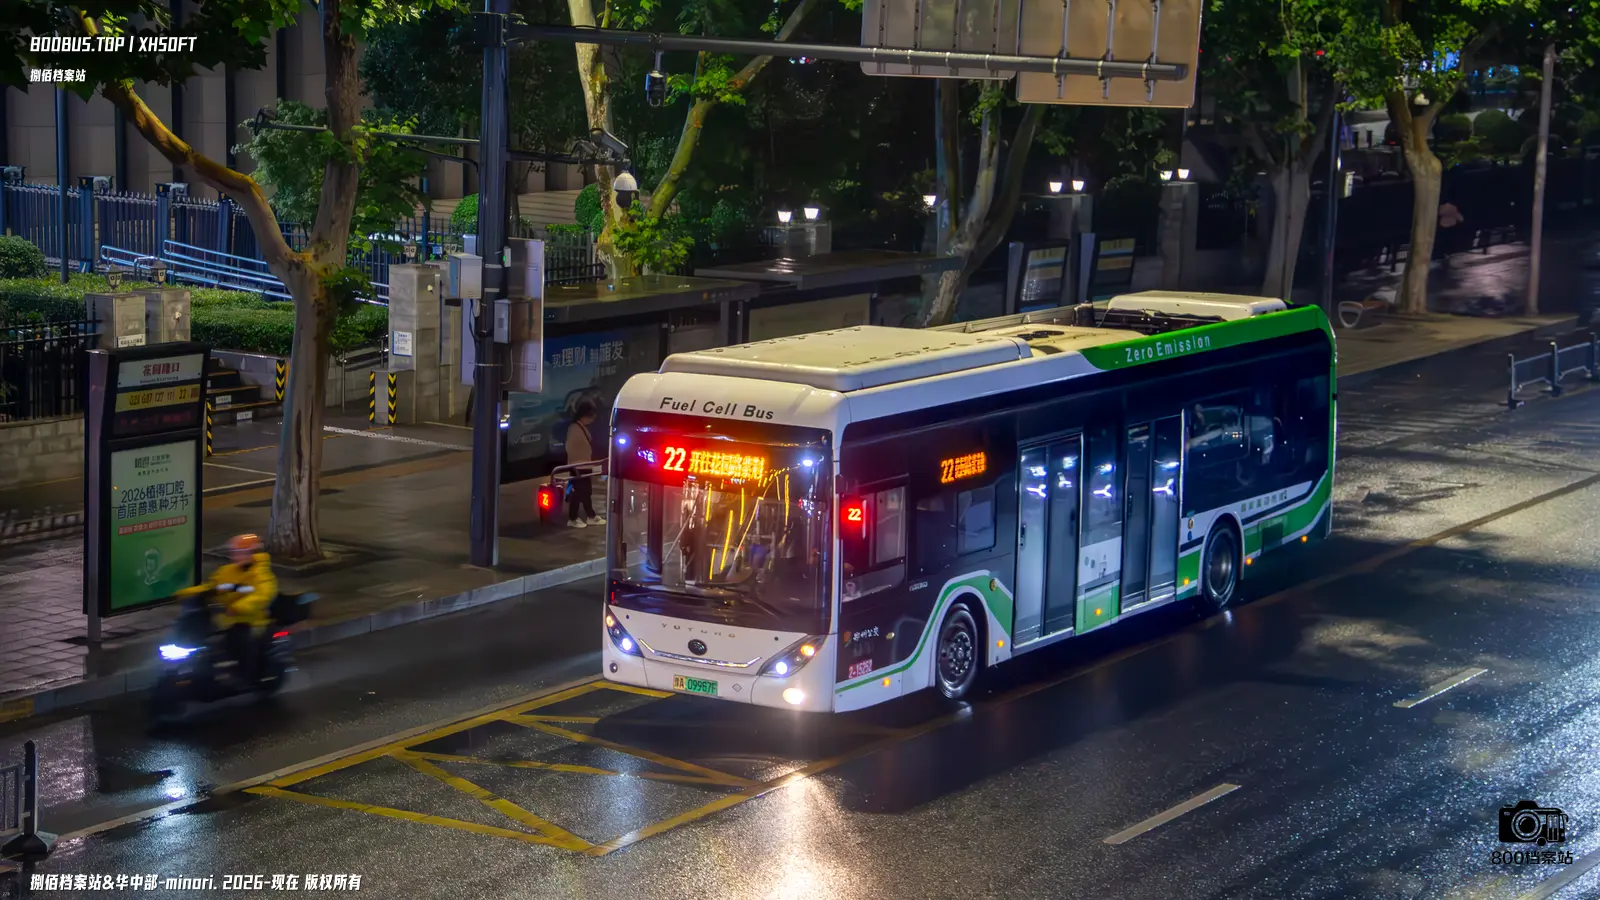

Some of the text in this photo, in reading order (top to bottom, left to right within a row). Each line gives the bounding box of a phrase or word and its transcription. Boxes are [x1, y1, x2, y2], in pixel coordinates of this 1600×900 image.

[1125, 335, 1211, 363] Zero Emission
[660, 396, 775, 420] Fuel Cell Bus
[663, 446, 687, 472] 22
[940, 458, 955, 484] 22
[848, 507, 862, 521] 22
